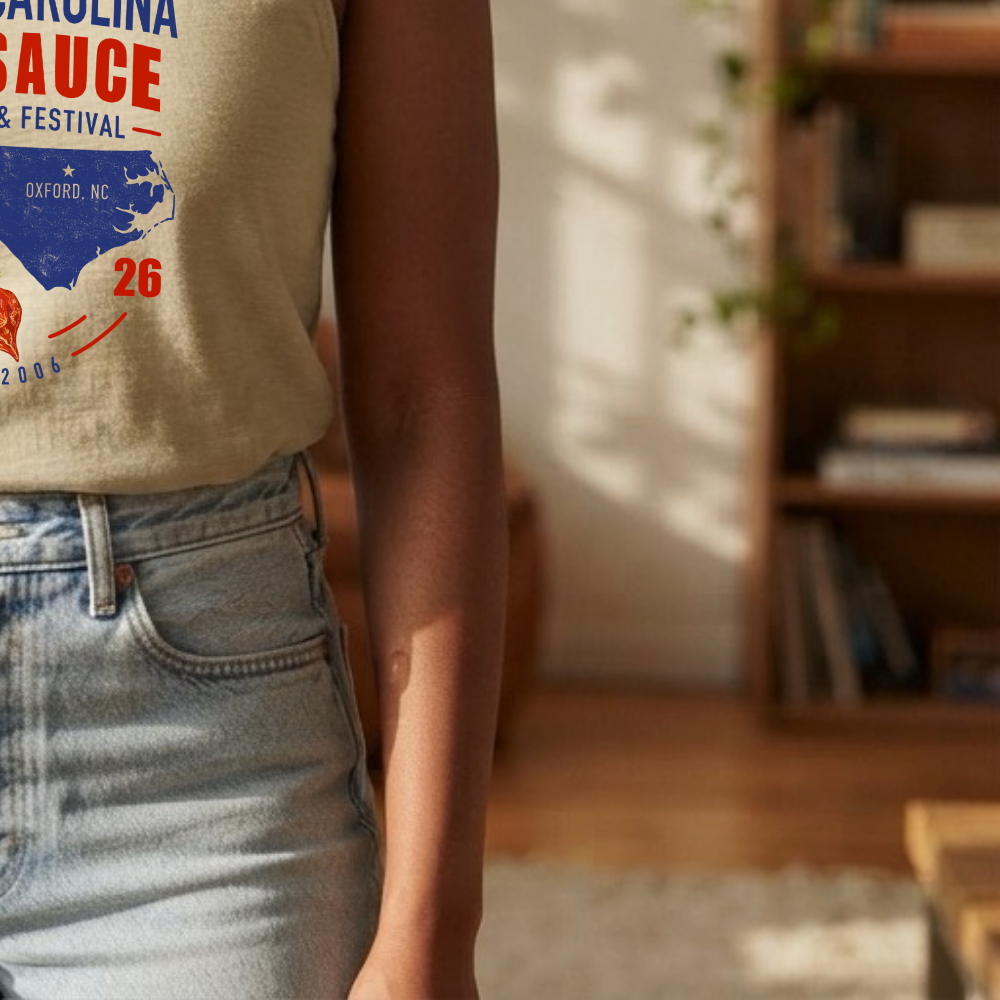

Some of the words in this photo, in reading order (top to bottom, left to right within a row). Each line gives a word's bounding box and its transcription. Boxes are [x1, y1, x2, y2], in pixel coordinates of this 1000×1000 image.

[21, 105, 126, 140] FESTIVAL
[25, 181, 85, 201] OXFORD,
[90, 183, 110, 201] NC
[113, 257, 163, 299] 26
[1, 355, 62, 386] 2006
